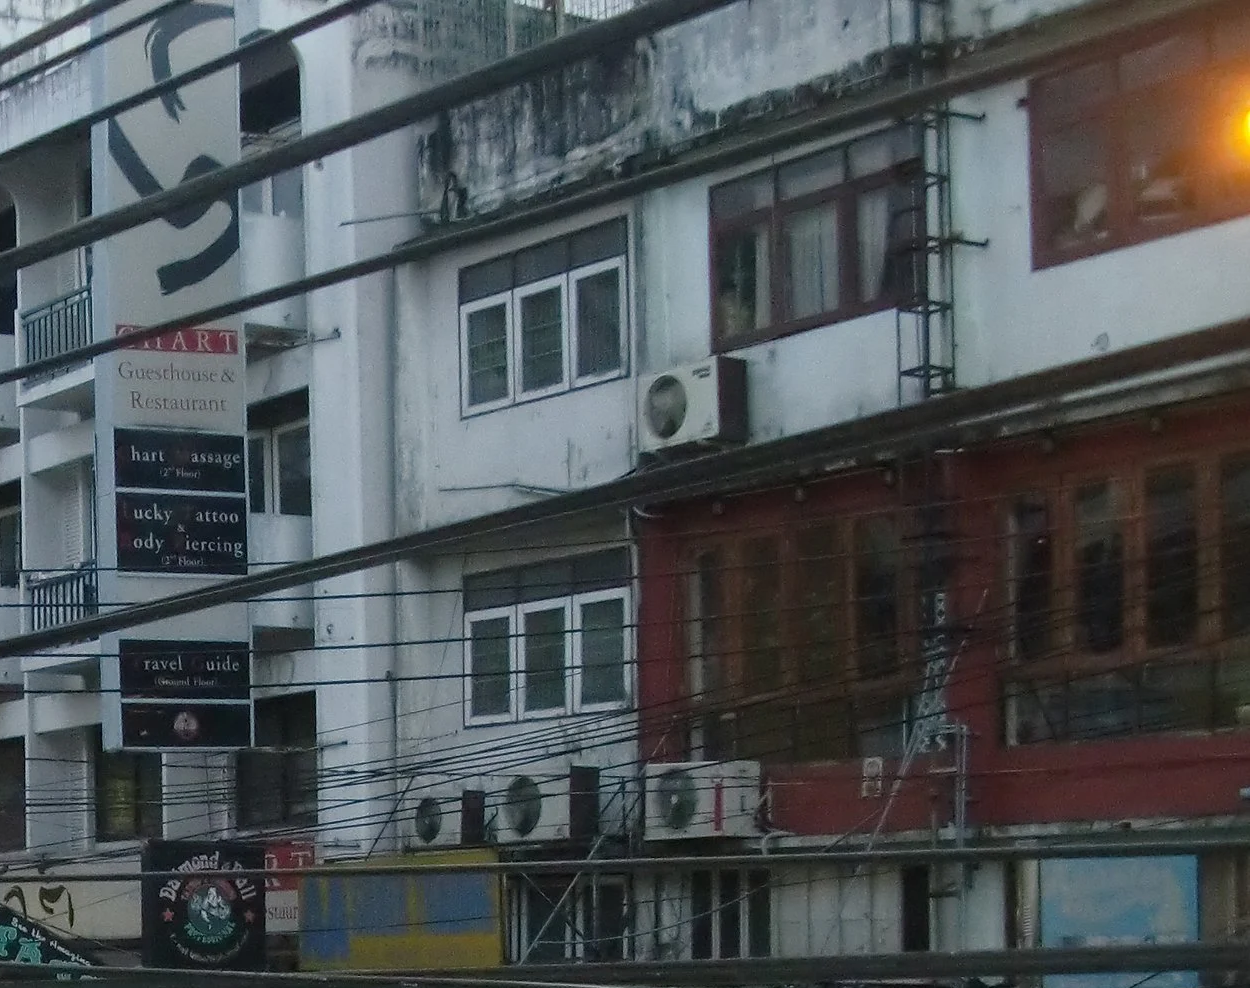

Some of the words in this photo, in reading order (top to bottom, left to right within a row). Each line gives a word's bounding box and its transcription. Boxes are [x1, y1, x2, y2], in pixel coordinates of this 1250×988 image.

[118, 361, 218, 383] Guesthouse
[221, 369, 236, 384] &
[130, 391, 228, 412] Restaurant
